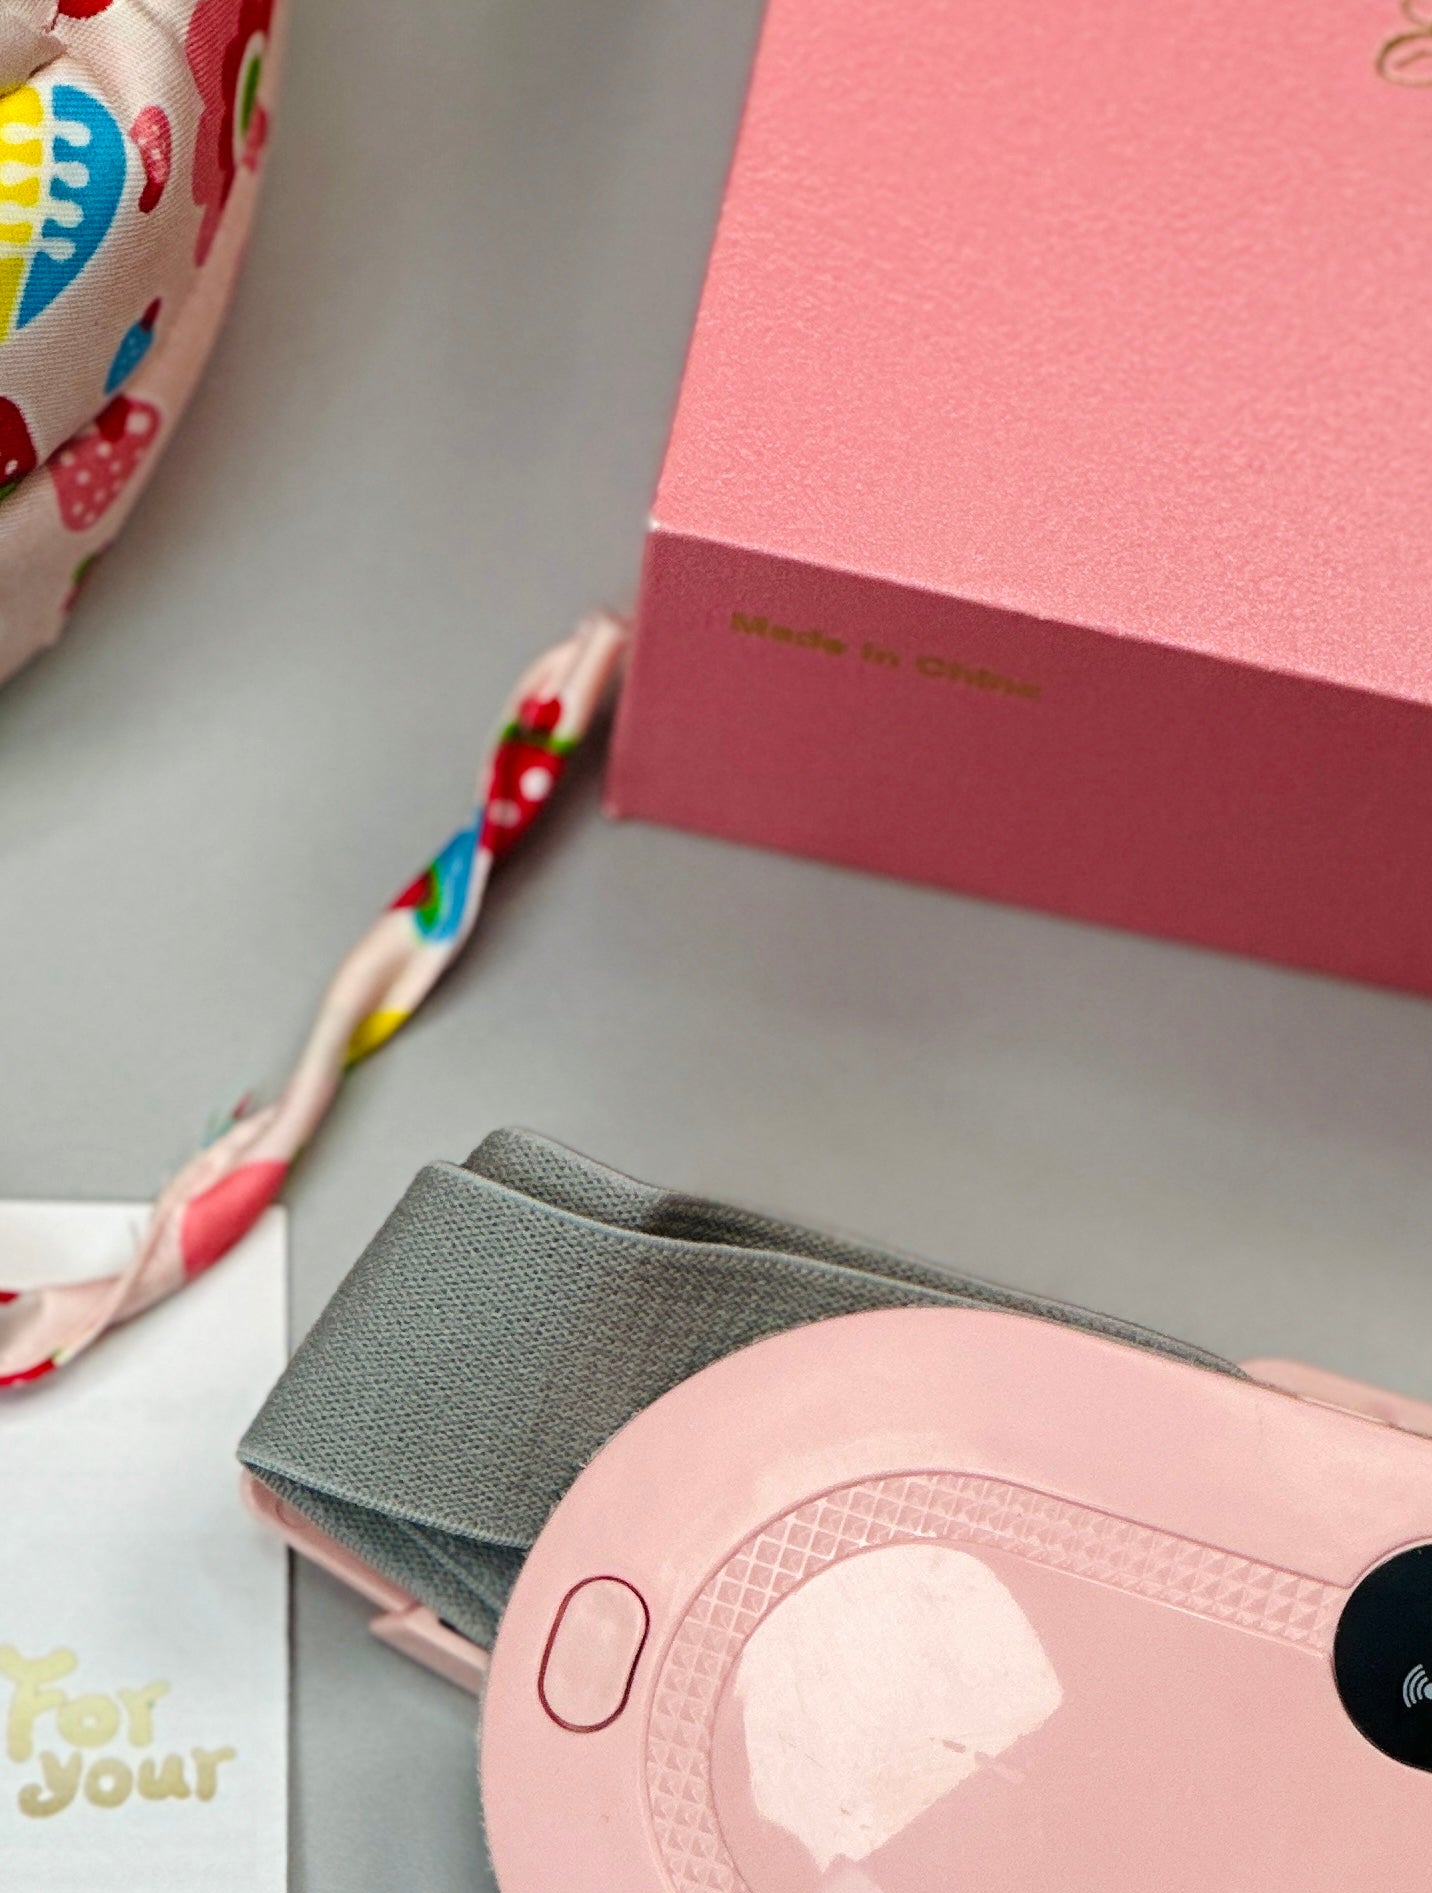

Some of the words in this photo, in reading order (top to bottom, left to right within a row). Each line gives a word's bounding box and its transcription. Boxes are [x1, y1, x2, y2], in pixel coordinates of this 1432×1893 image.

[729, 611, 847, 656] Made
[859, 640, 900, 670] in
[914, 654, 1042, 701] China
[0, 1643, 170, 1763] For
[17, 1746, 237, 1819] your
